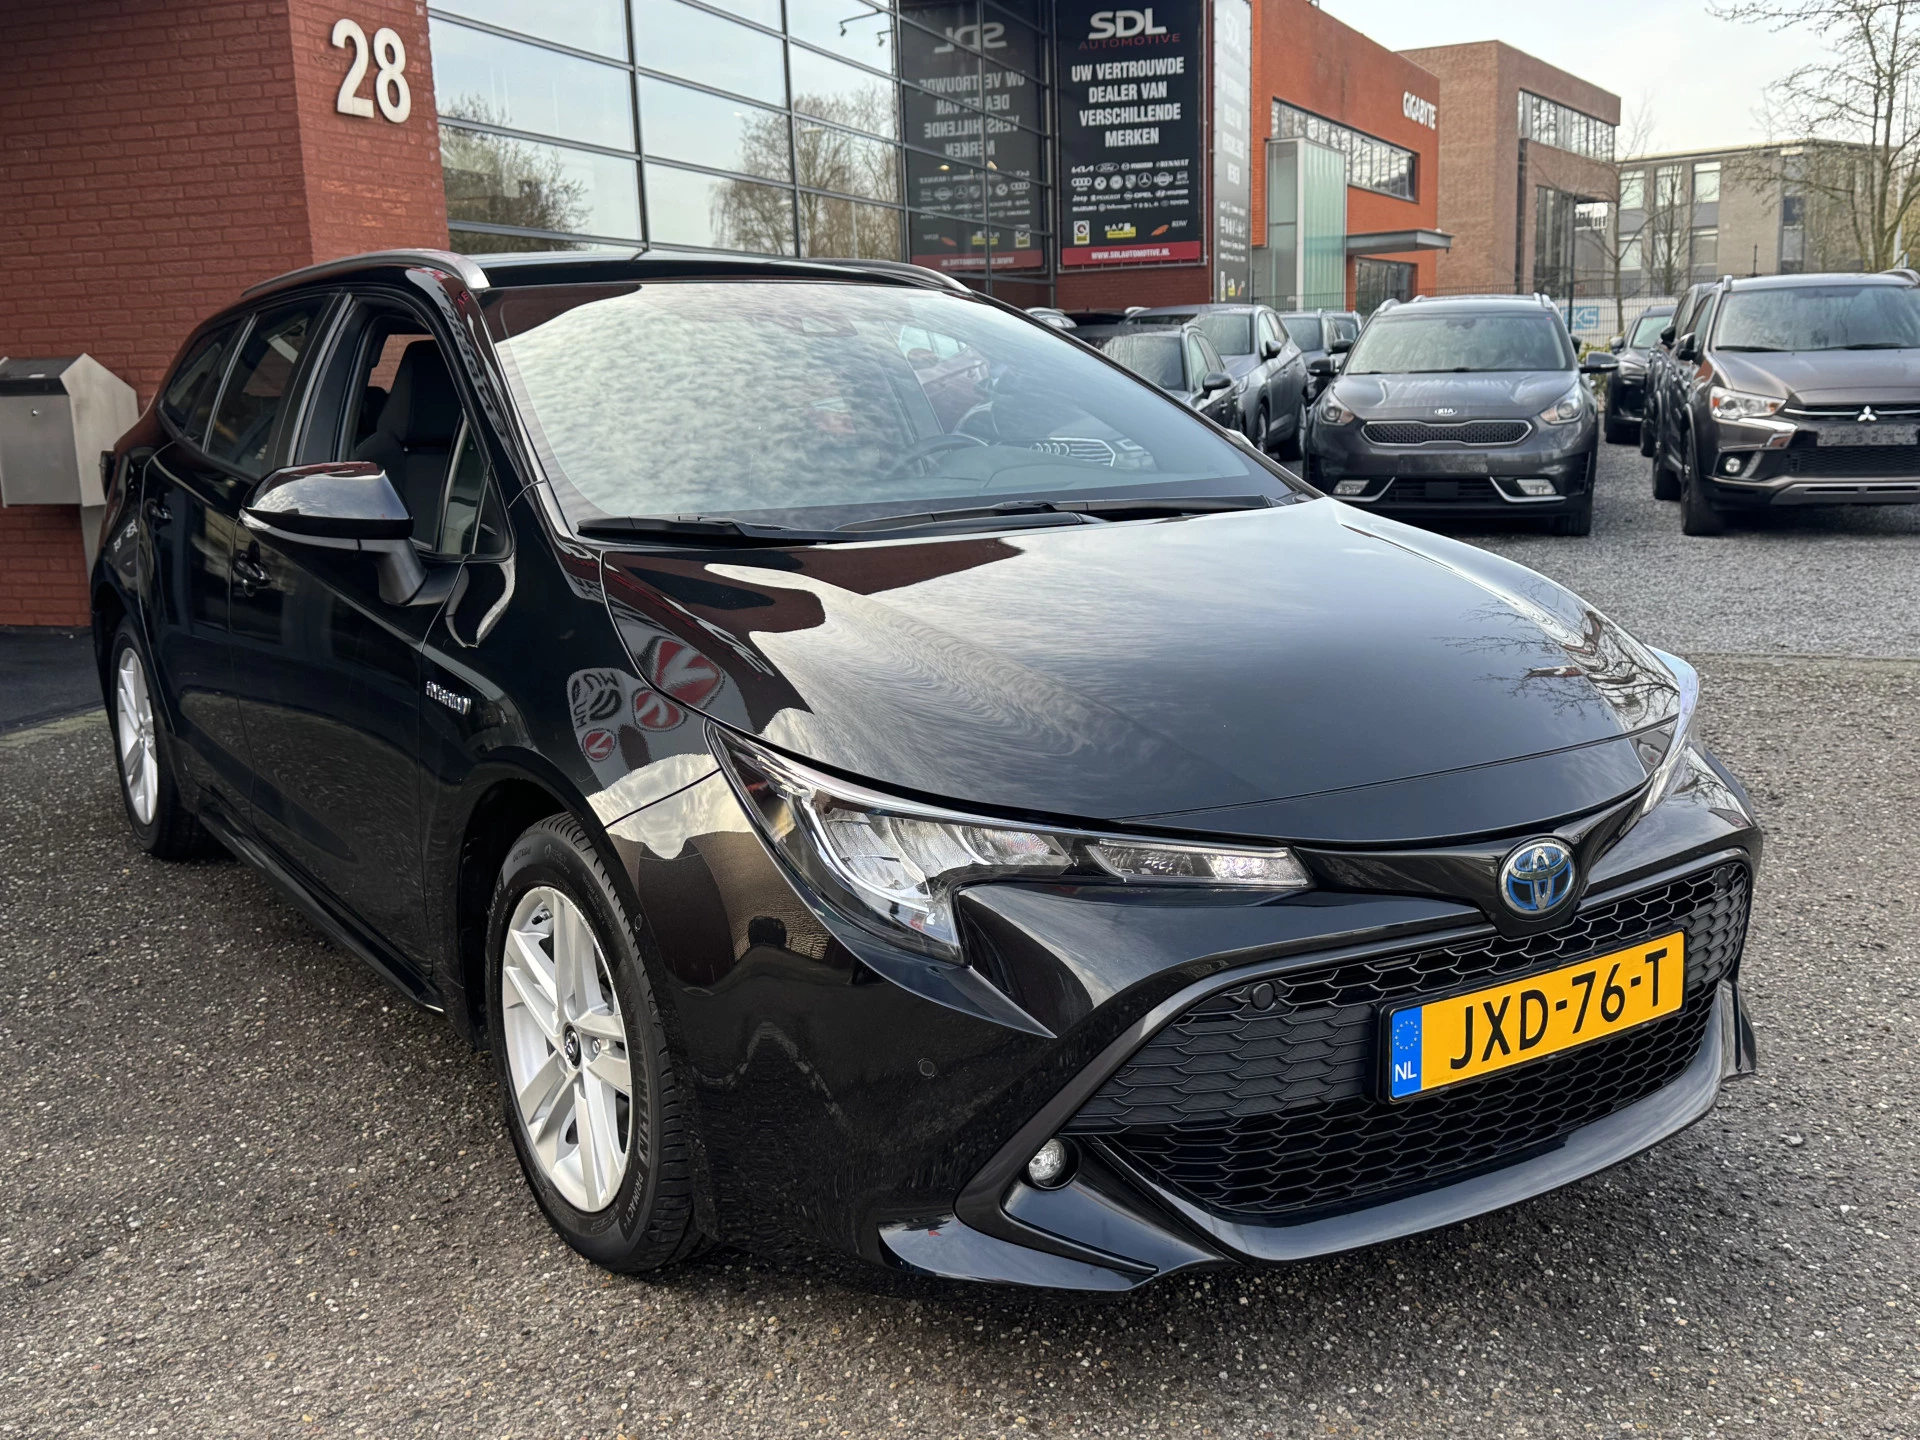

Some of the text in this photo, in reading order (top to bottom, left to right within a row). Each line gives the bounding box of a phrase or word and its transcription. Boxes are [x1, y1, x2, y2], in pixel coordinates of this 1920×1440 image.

[1088, 8, 1167, 39] SDL
[1079, 33, 1180, 50] AUTOMOTIVE
[331, 18, 411, 123] 28
[1072, 57, 1184, 82] UW VERTROUWDE
[1088, 81, 1167, 103] DEALER VAN
[1079, 103, 1181, 127] VERSCHILLENDE
[1403, 91, 1437, 130] GIGABYTE
[1105, 127, 1160, 148] MERKEN
[1450, 947, 1668, 1070] JXD-76-T
[1395, 1061, 1417, 1082] NL
